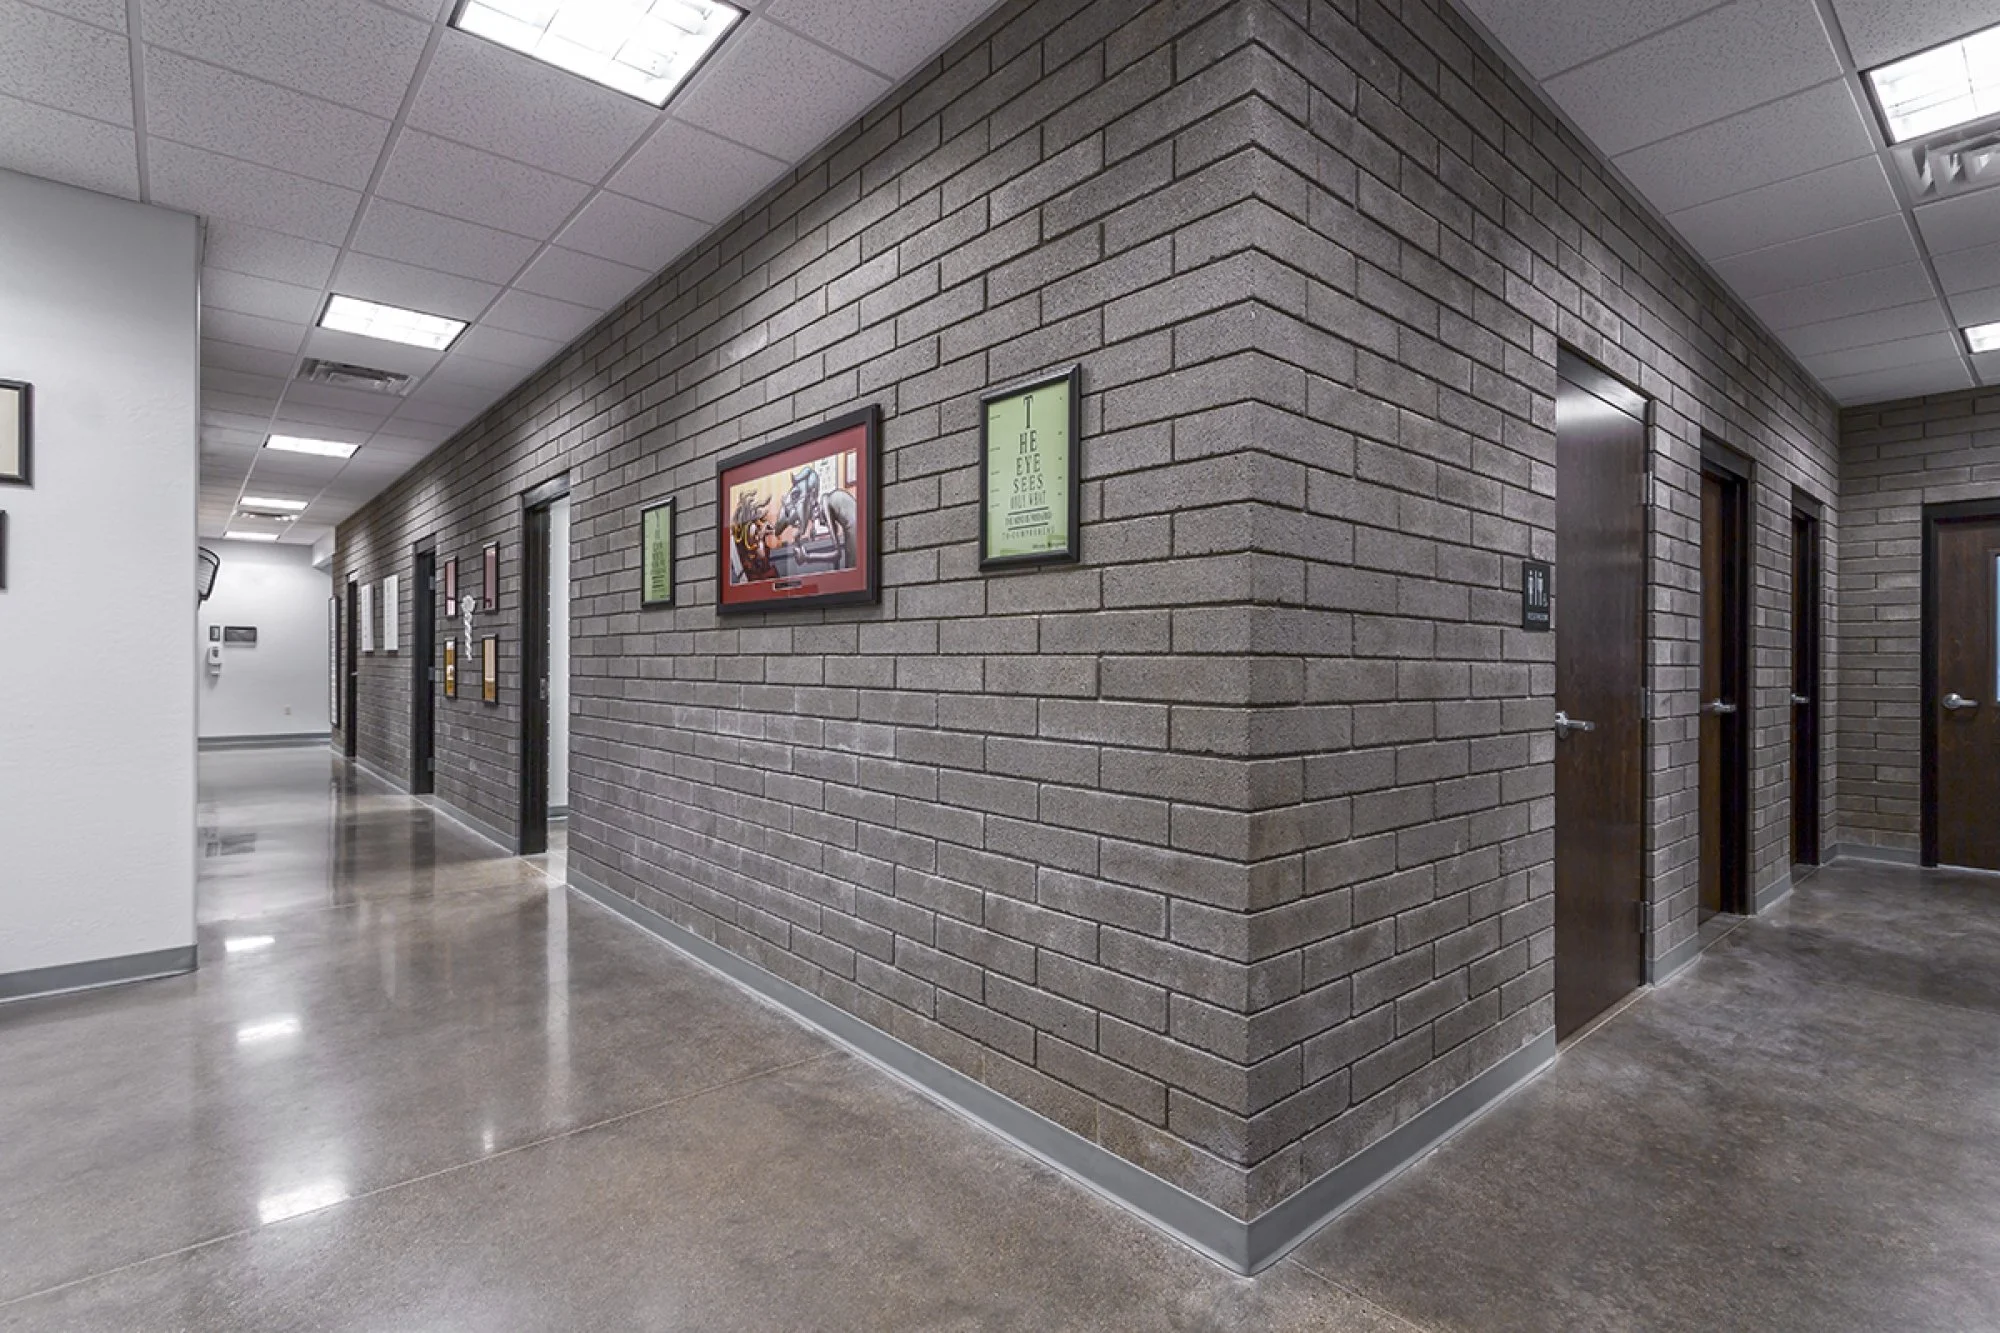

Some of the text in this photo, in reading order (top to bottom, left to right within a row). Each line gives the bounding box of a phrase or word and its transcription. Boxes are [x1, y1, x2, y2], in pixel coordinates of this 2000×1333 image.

[1023, 394, 1034, 429] T
[1019, 429, 1038, 454] HE
[1016, 453, 1041, 476] EYE
[1012, 473, 1044, 494] SEES
